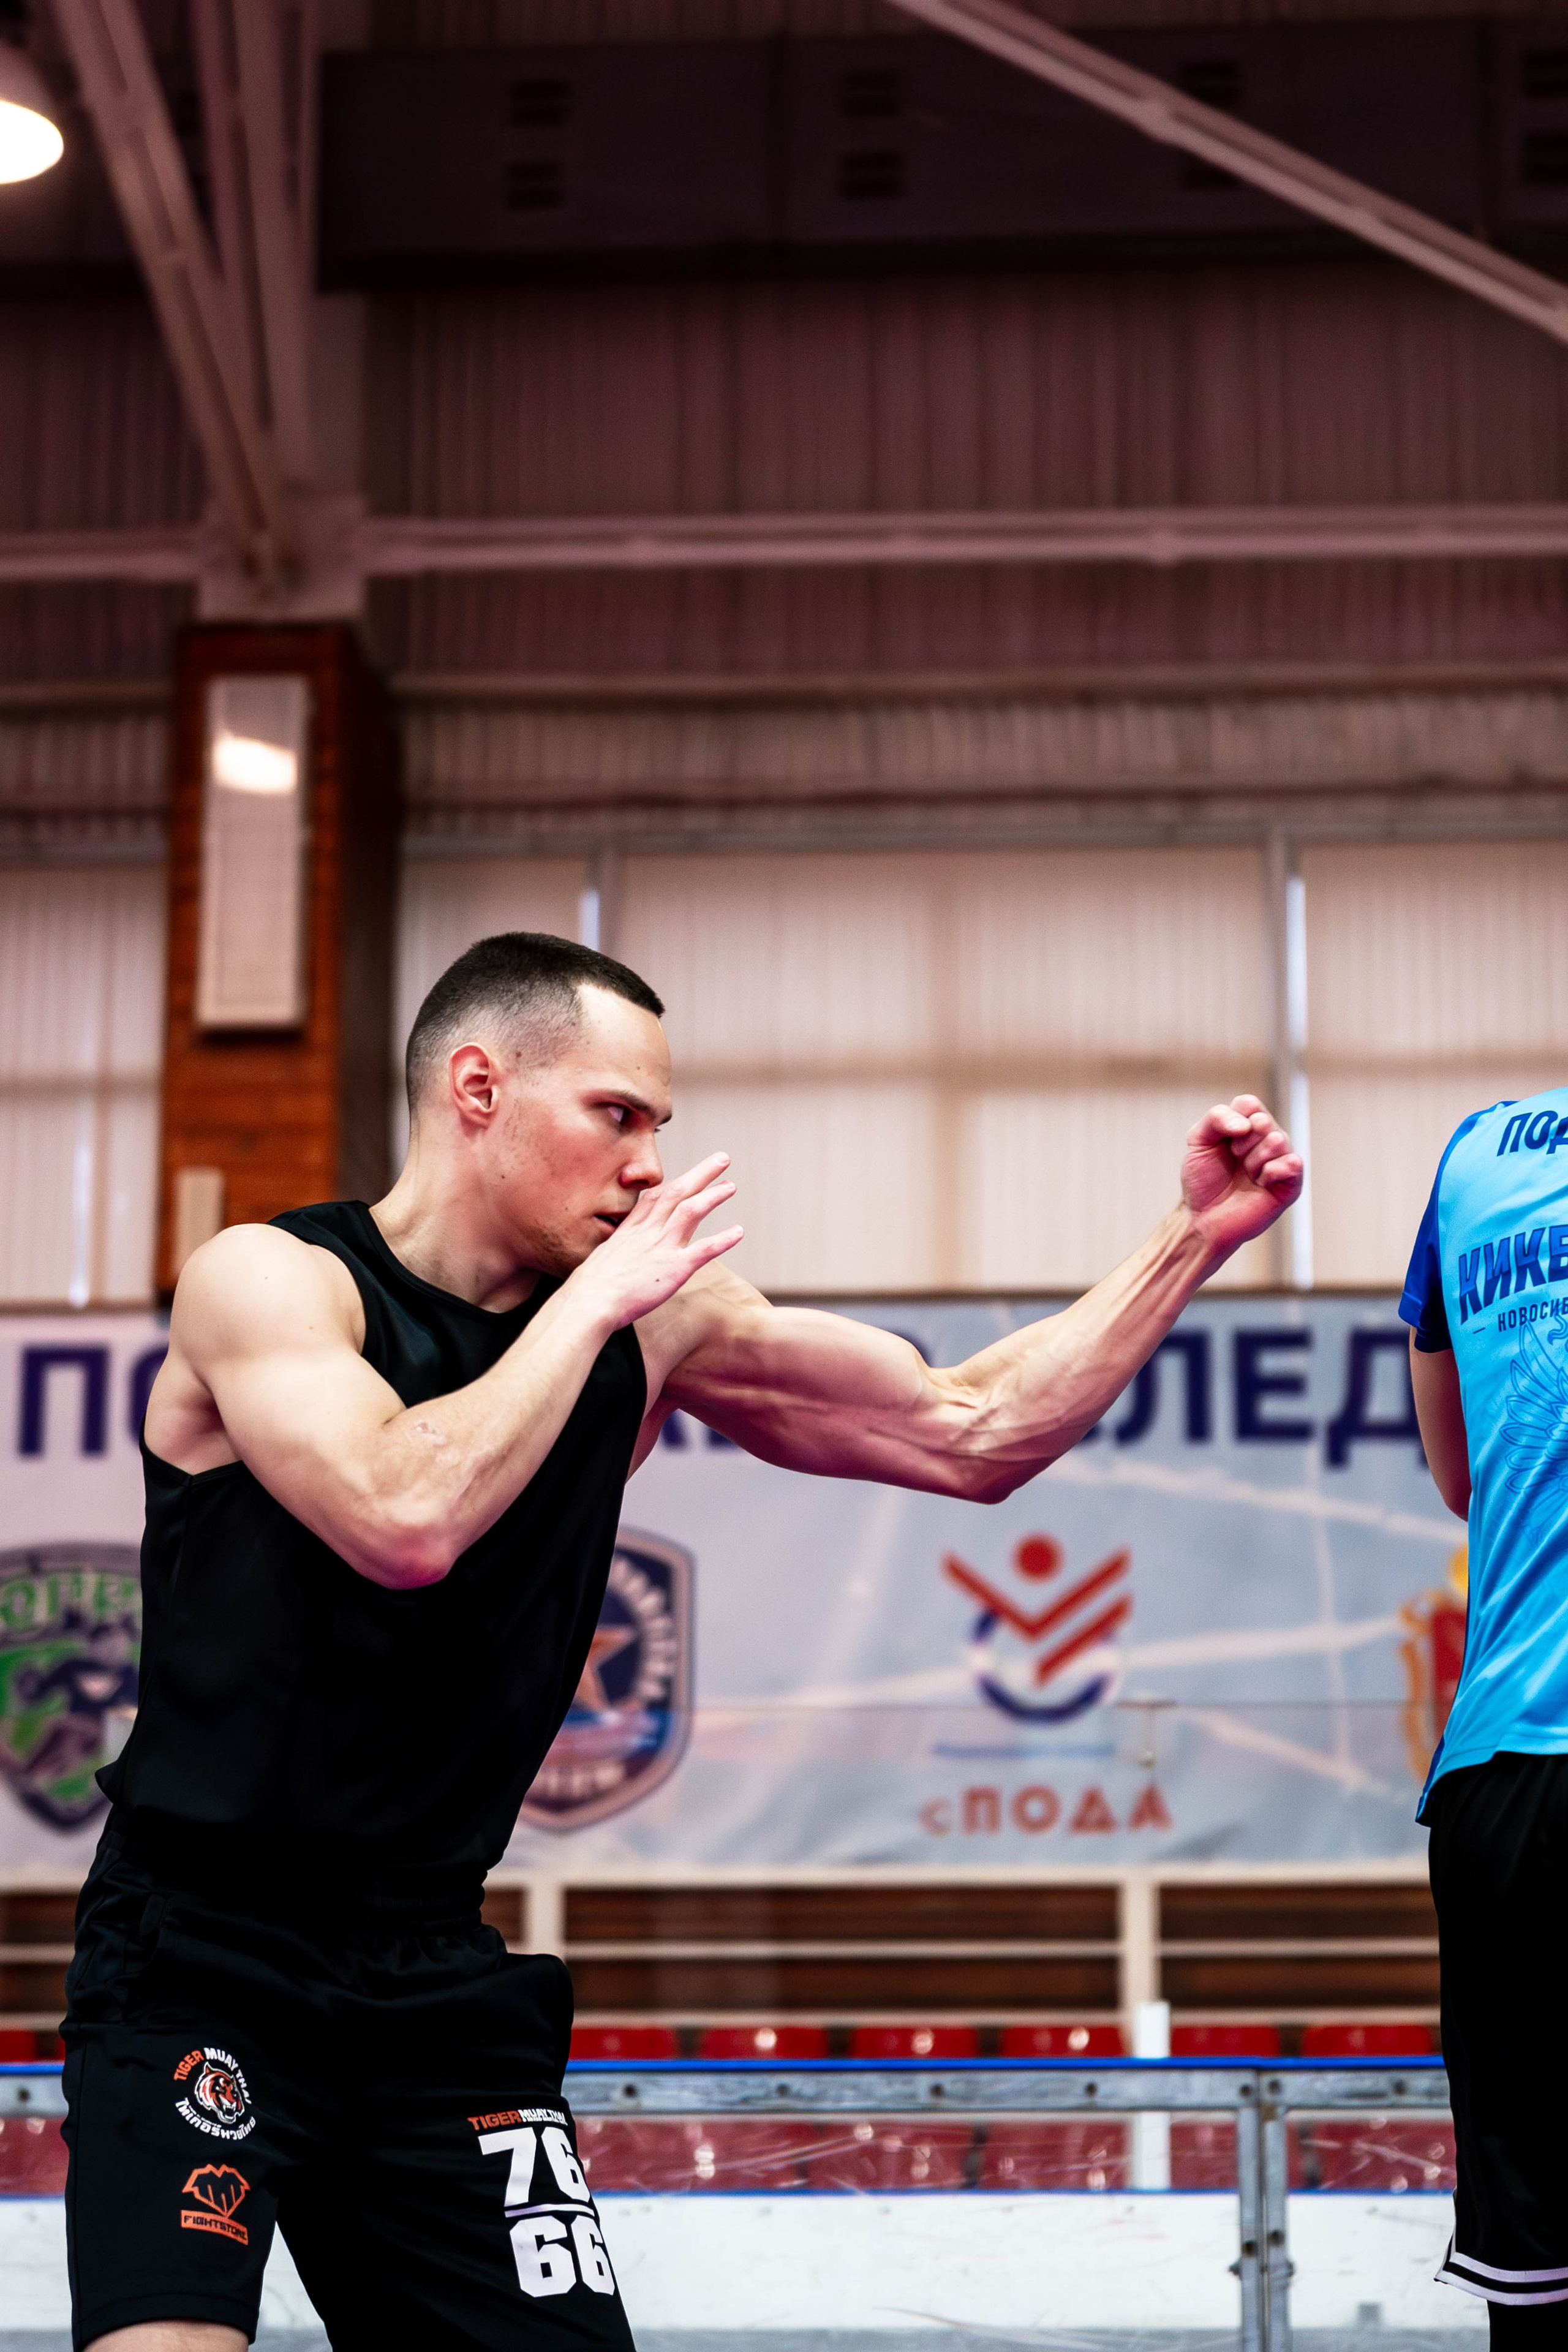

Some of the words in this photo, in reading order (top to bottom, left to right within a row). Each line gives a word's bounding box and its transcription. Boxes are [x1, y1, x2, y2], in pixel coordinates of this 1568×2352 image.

[173, 2050, 205, 2081] TIGER
[203, 2047, 238, 2071] MUAY
[467, 2109, 521, 2131] TIGER
[478, 2126, 591, 2207] 76
[510, 2214, 615, 2298] 66
